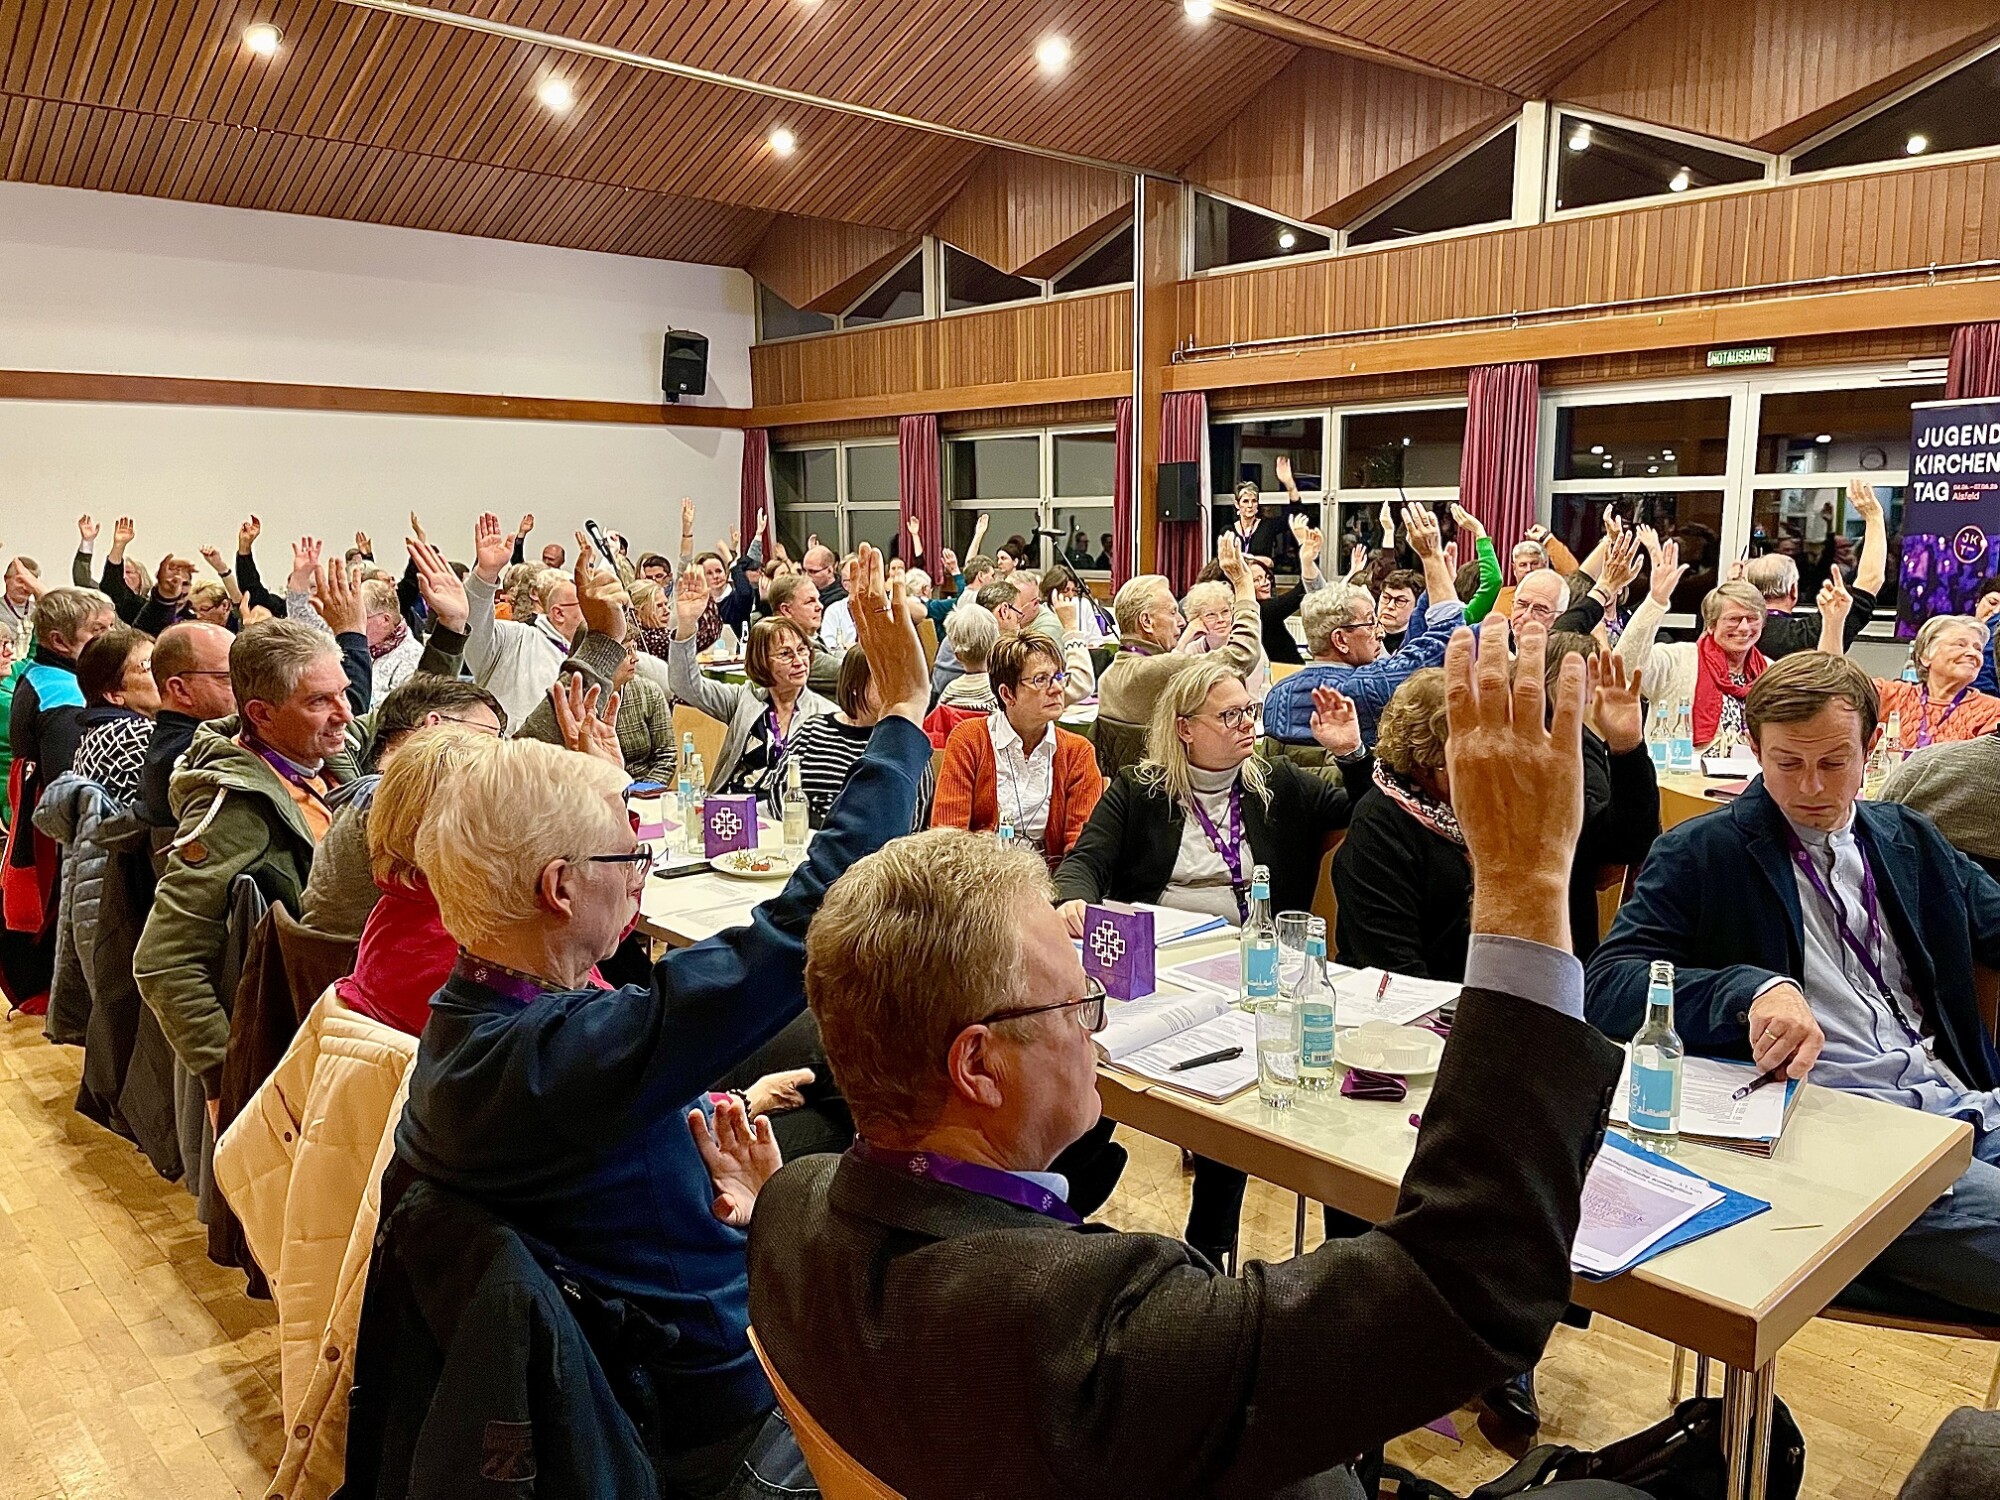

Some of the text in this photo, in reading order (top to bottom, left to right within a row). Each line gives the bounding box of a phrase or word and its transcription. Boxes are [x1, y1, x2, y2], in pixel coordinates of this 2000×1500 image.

[1711, 348, 1767, 365] NOTAUSGANG
[1917, 424, 2000, 448] JUGEND
[1914, 452, 2000, 475] KIRCHEN
[1913, 481, 1950, 502] TAG
[1952, 491, 1980, 500] Alsfeld
